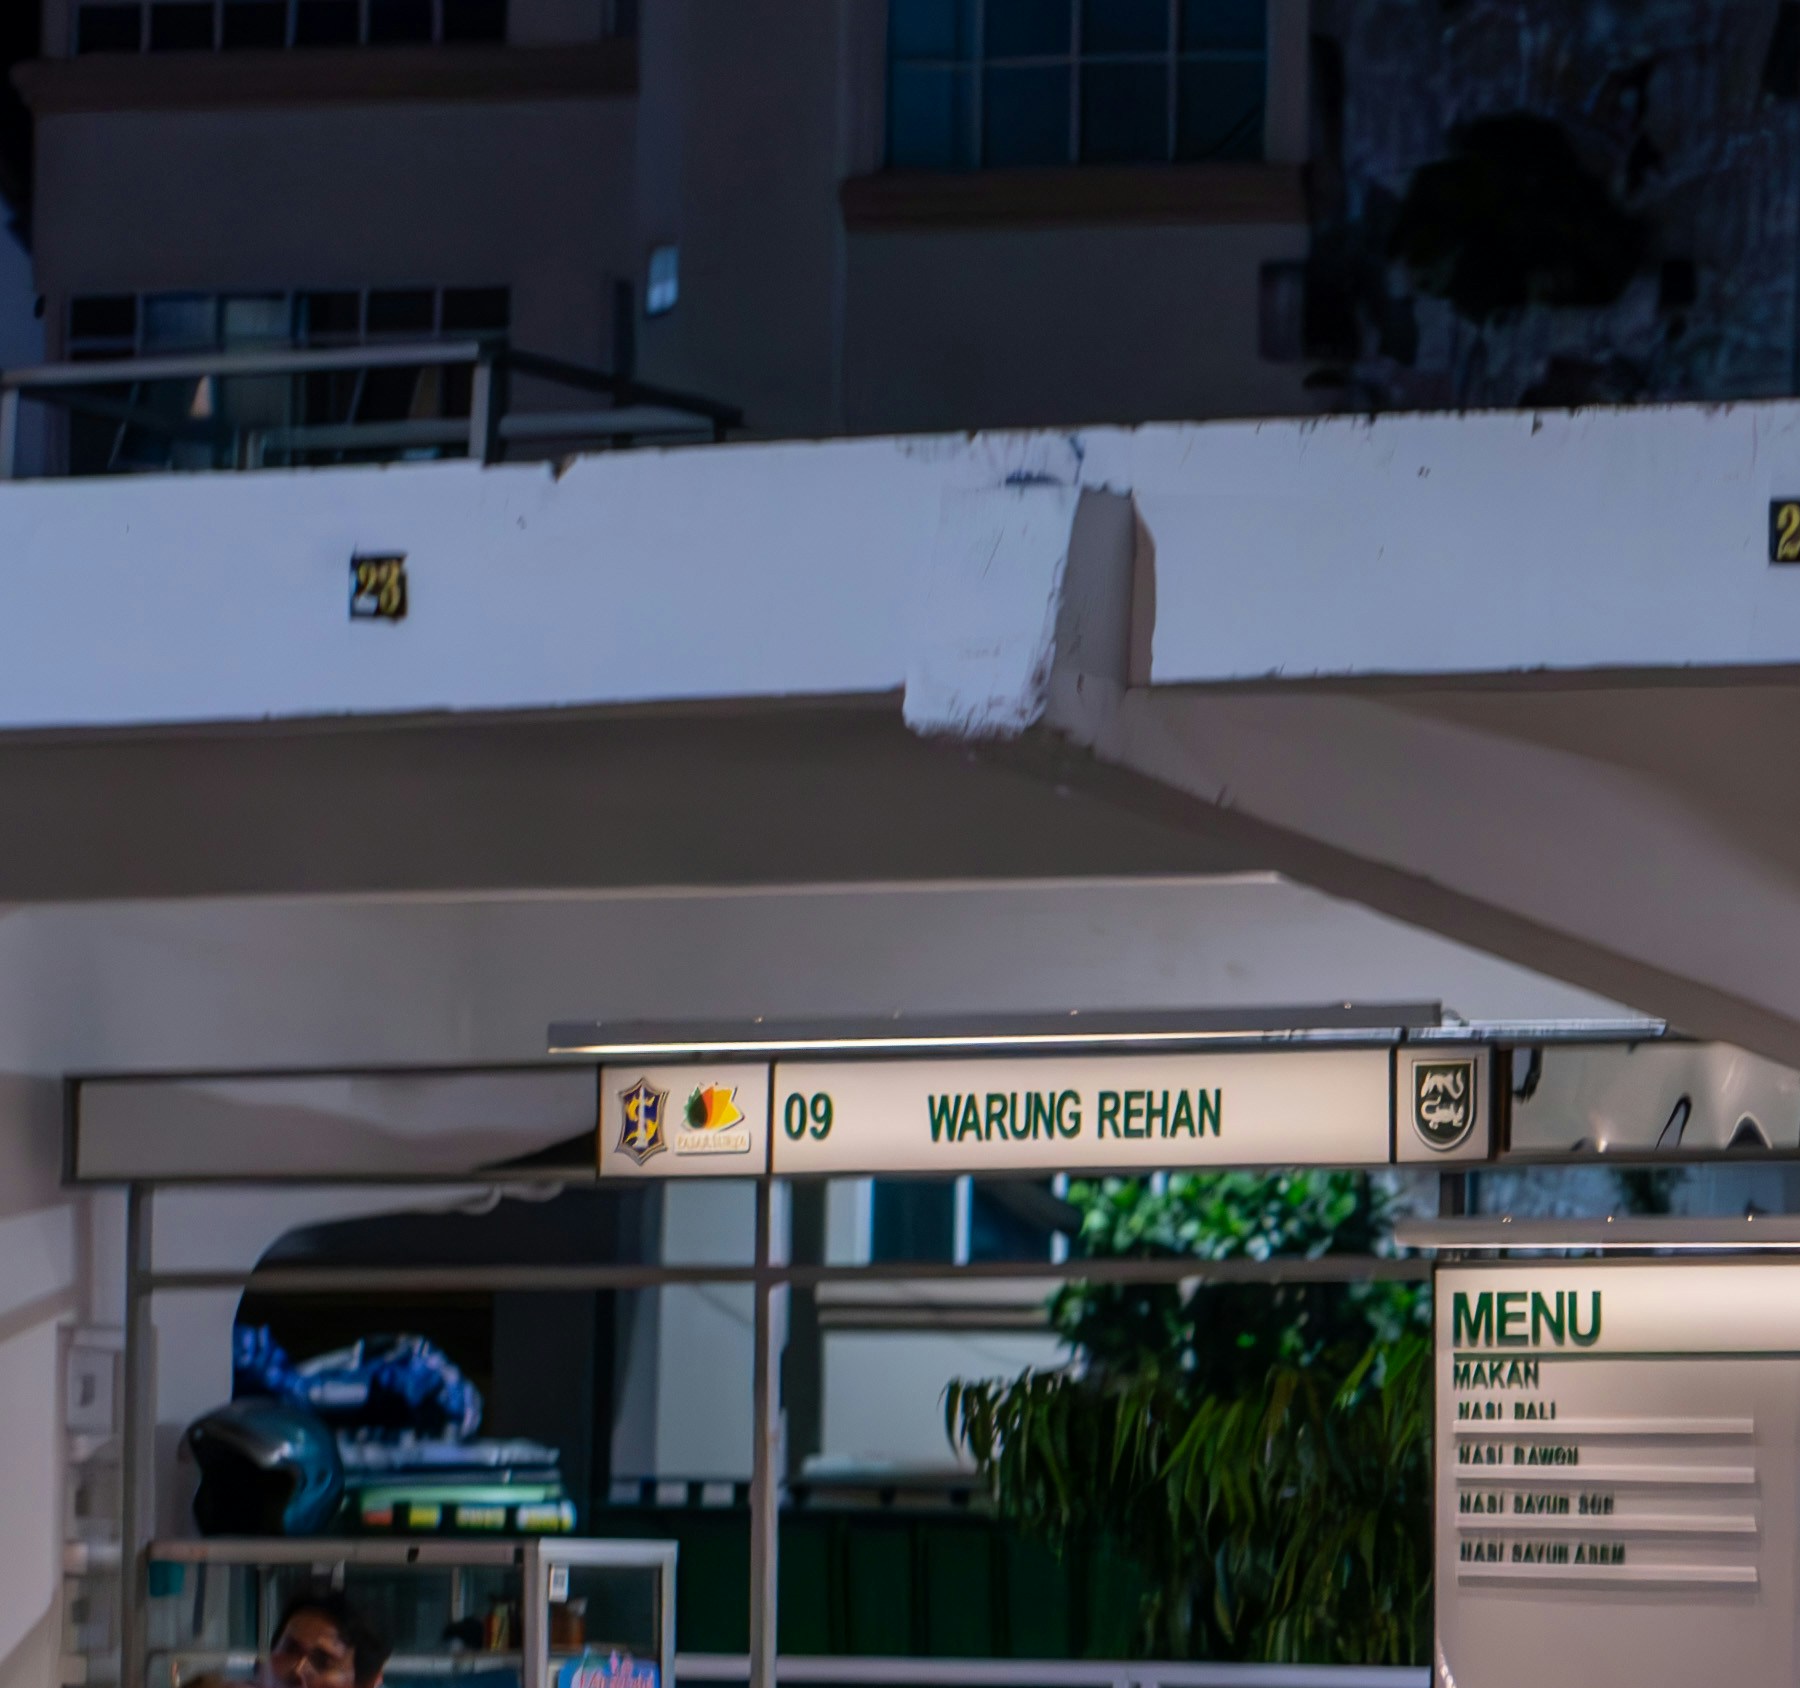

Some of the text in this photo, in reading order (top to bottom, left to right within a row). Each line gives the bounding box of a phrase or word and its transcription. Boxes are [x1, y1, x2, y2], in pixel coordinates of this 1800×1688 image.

[783, 1088, 1222, 1143] 09 WARUNG REHAN
[1452, 1290, 1602, 1346] MENU
[1453, 1361, 1540, 1390] MAKAN
